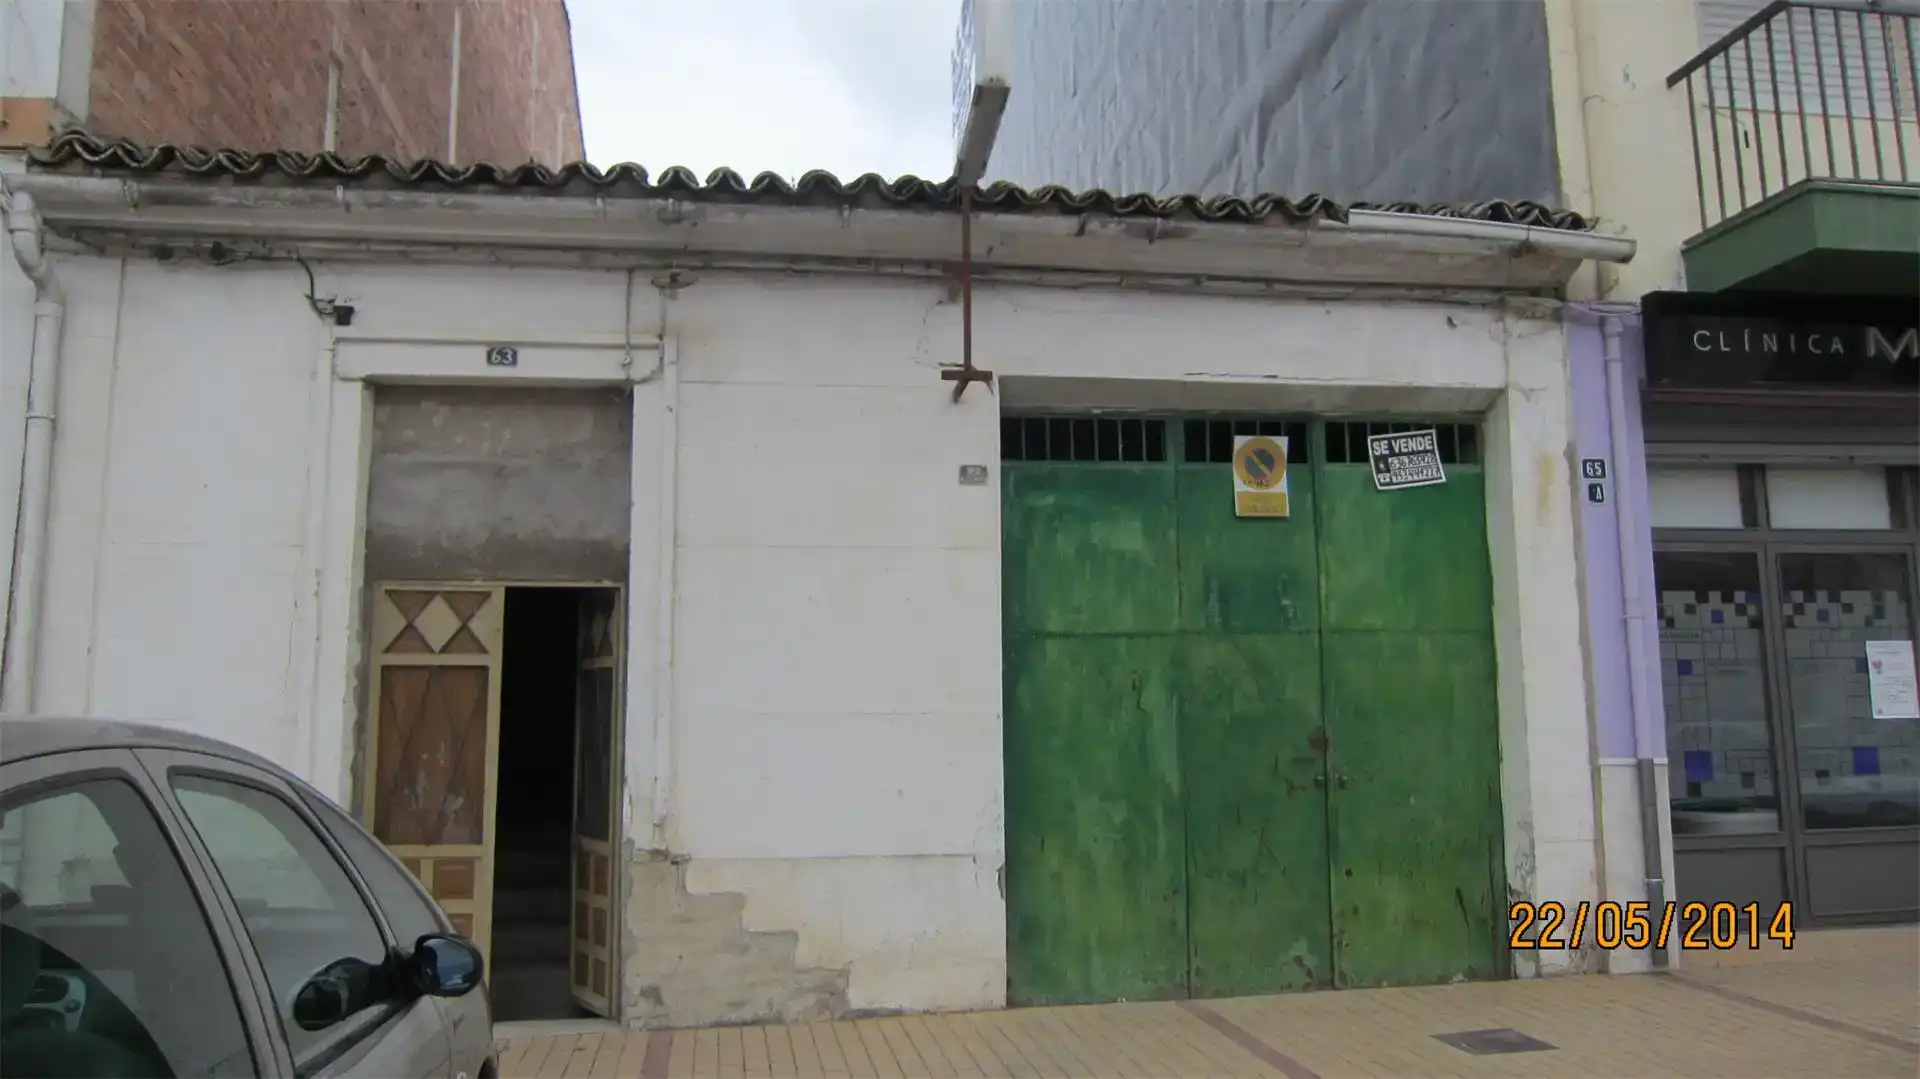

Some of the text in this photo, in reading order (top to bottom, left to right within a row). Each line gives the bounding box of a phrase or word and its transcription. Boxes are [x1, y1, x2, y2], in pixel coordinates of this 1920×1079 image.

[491, 347, 514, 365] 63
[1372, 435, 1434, 456] SE VENDE
[1586, 461, 1602, 477] 65
